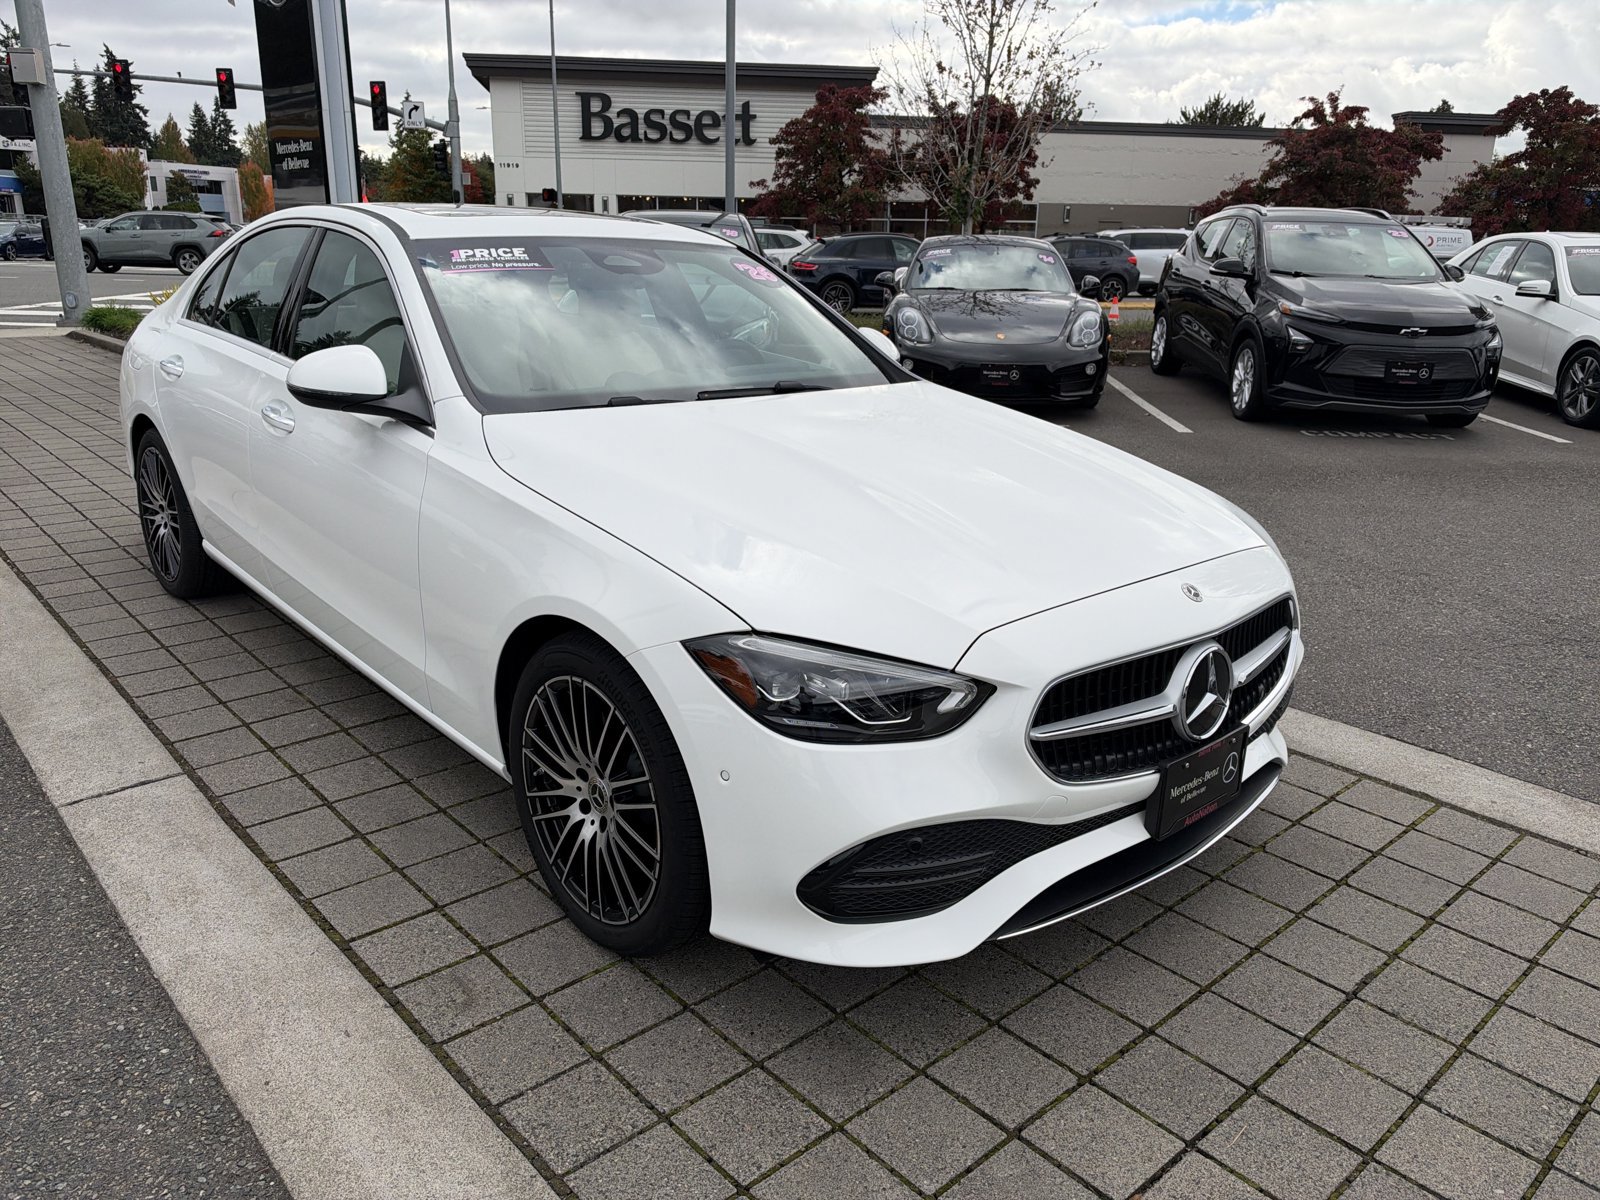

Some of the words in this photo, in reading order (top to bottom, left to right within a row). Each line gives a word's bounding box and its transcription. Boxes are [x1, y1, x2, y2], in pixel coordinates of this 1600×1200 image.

[275, 139, 313, 155] Mercedes-Benz
[282, 158, 288, 170] of
[288, 157, 310, 170] Bellevue
[1436, 236, 1462, 244] PRIME
[449, 247, 528, 259] 1PRICE
[469, 262, 490, 270] price.
[1300, 429, 1455, 441] COMPACT
[1169, 766, 1220, 800] Mercedes-Benz
[1180, 796, 1187, 804] of
[1186, 786, 1207, 801] Bellevue
